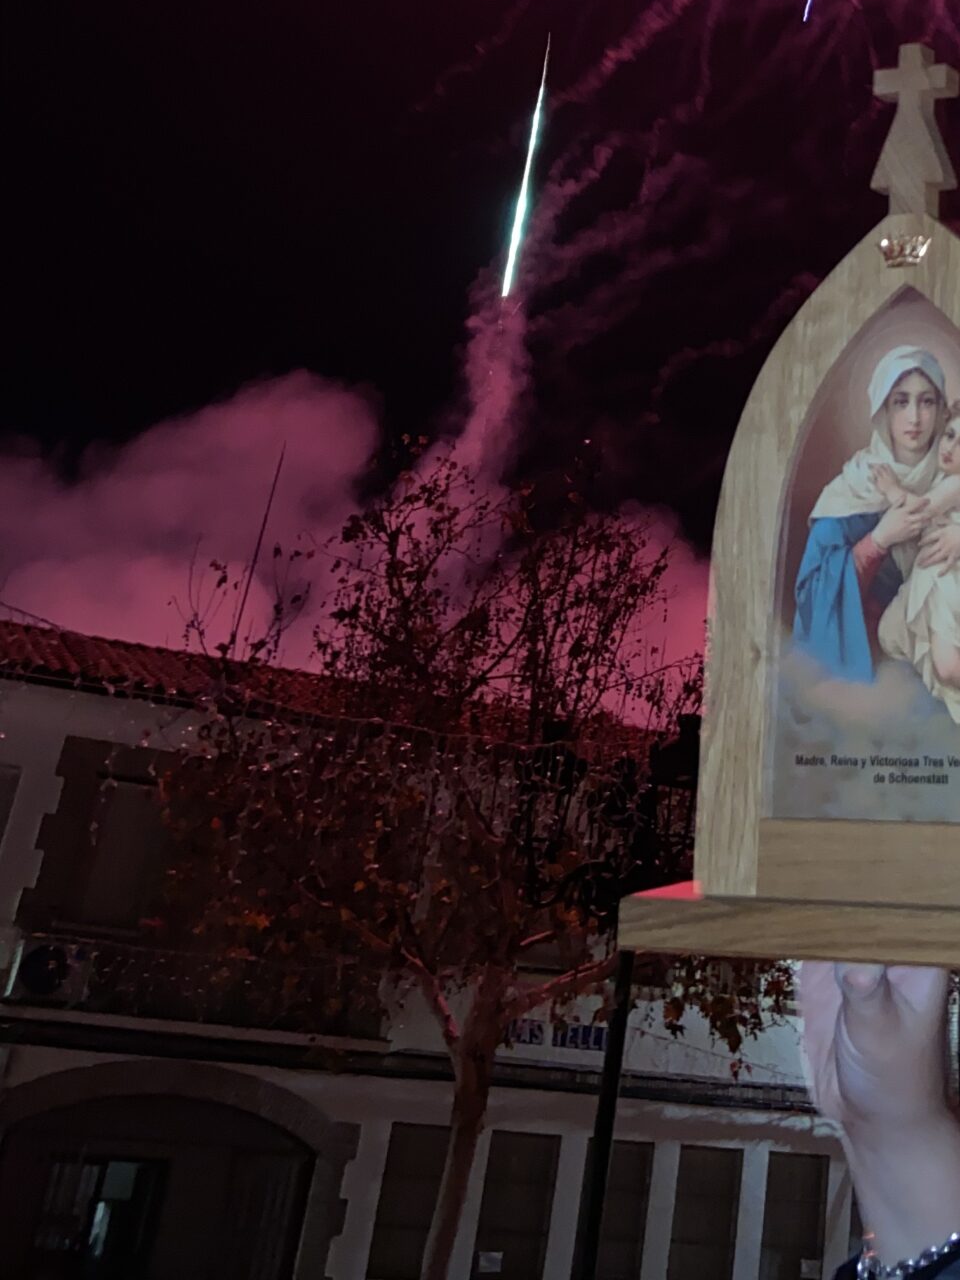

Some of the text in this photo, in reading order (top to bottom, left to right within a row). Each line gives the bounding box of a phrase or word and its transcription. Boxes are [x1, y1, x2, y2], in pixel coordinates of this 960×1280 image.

[794, 754, 827, 768] Madre,
[830, 755, 858, 766] Reina
[860, 758, 867, 769] y
[870, 756, 920, 768] Victoriosa
[923, 756, 944, 768] Tres
[873, 772, 949, 784] de Schoenstatt
